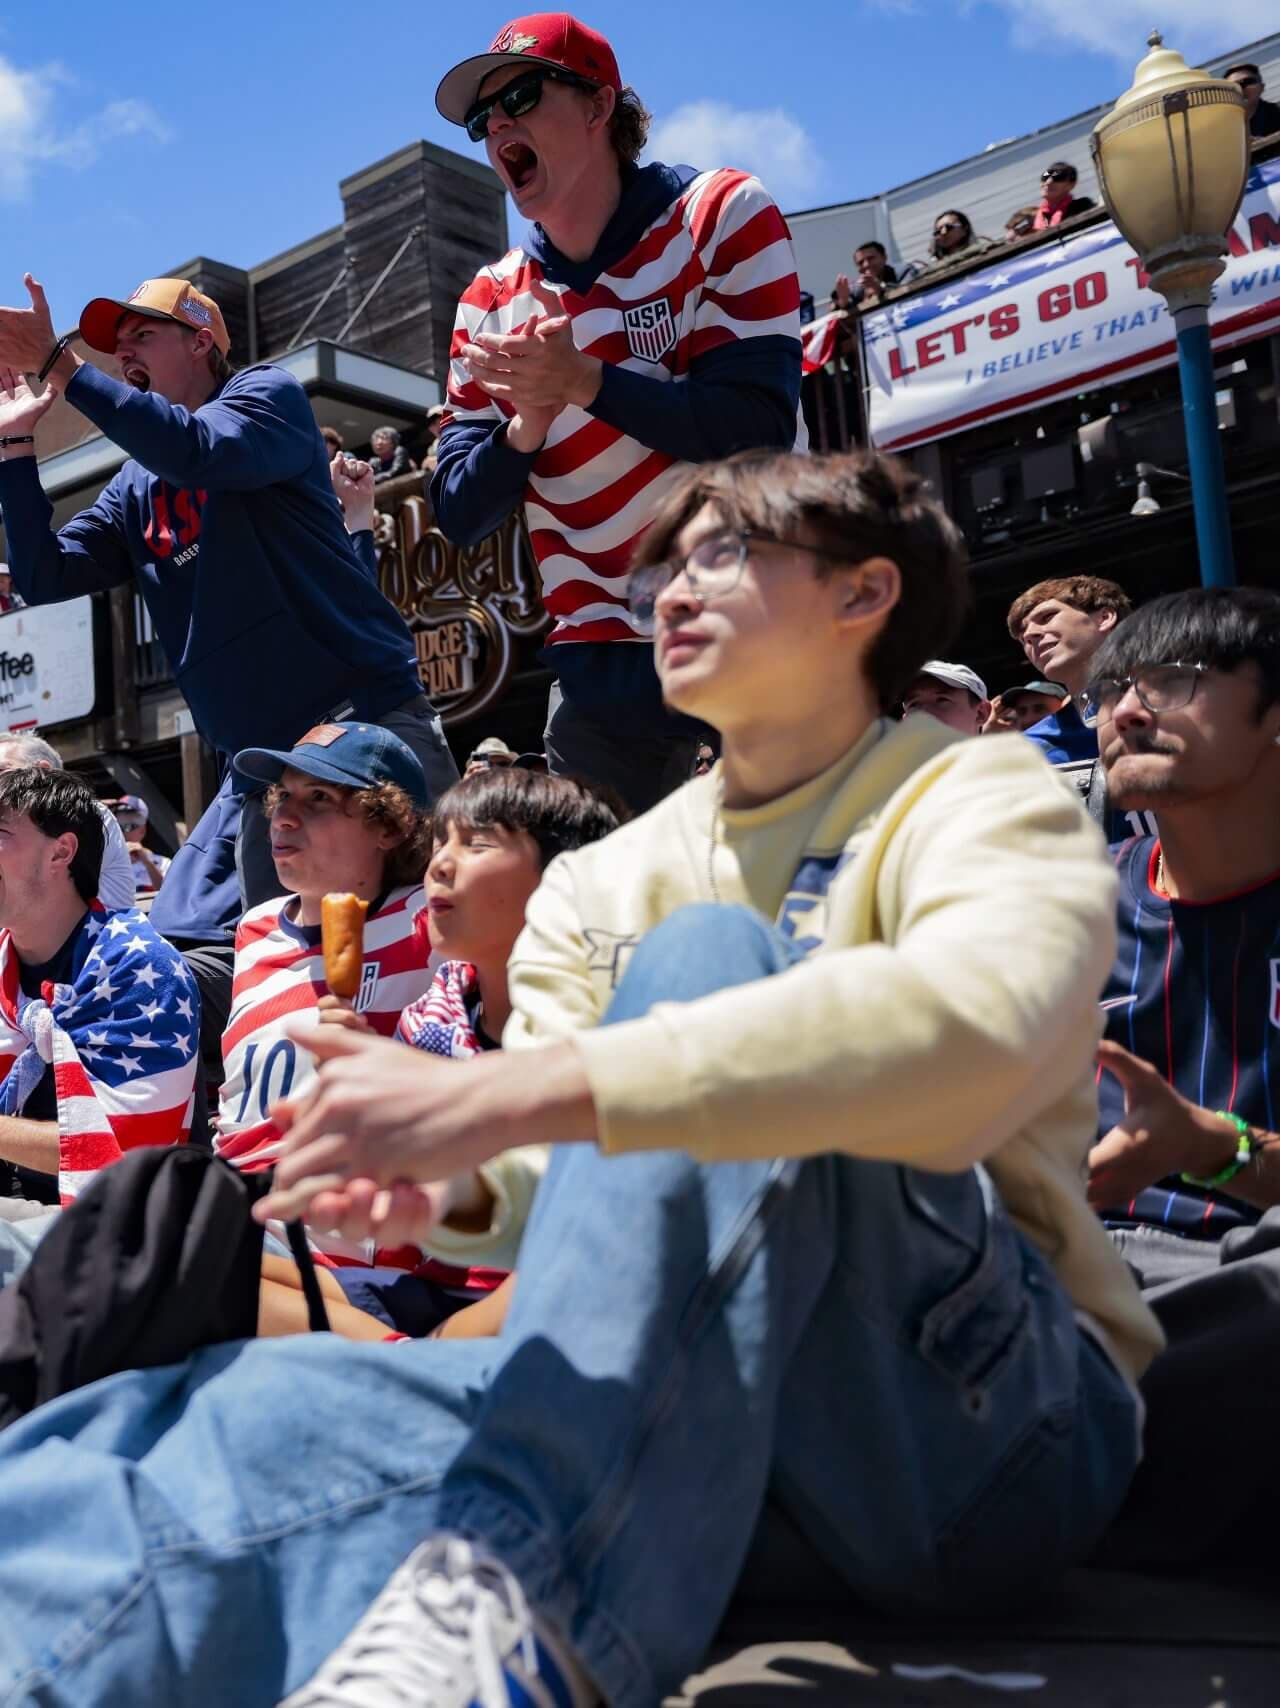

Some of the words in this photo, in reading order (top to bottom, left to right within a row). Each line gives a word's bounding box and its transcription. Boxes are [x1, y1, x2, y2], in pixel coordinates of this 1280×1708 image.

[627, 301, 668, 329] USA
[888, 302, 1020, 380] LET'S
[1038, 271, 1108, 323] GO
[966, 369, 974, 385] I
[982, 332, 1083, 379] BELIEVE
[1094, 302, 1165, 342] THAT
[234, 1038, 297, 1124] 10
